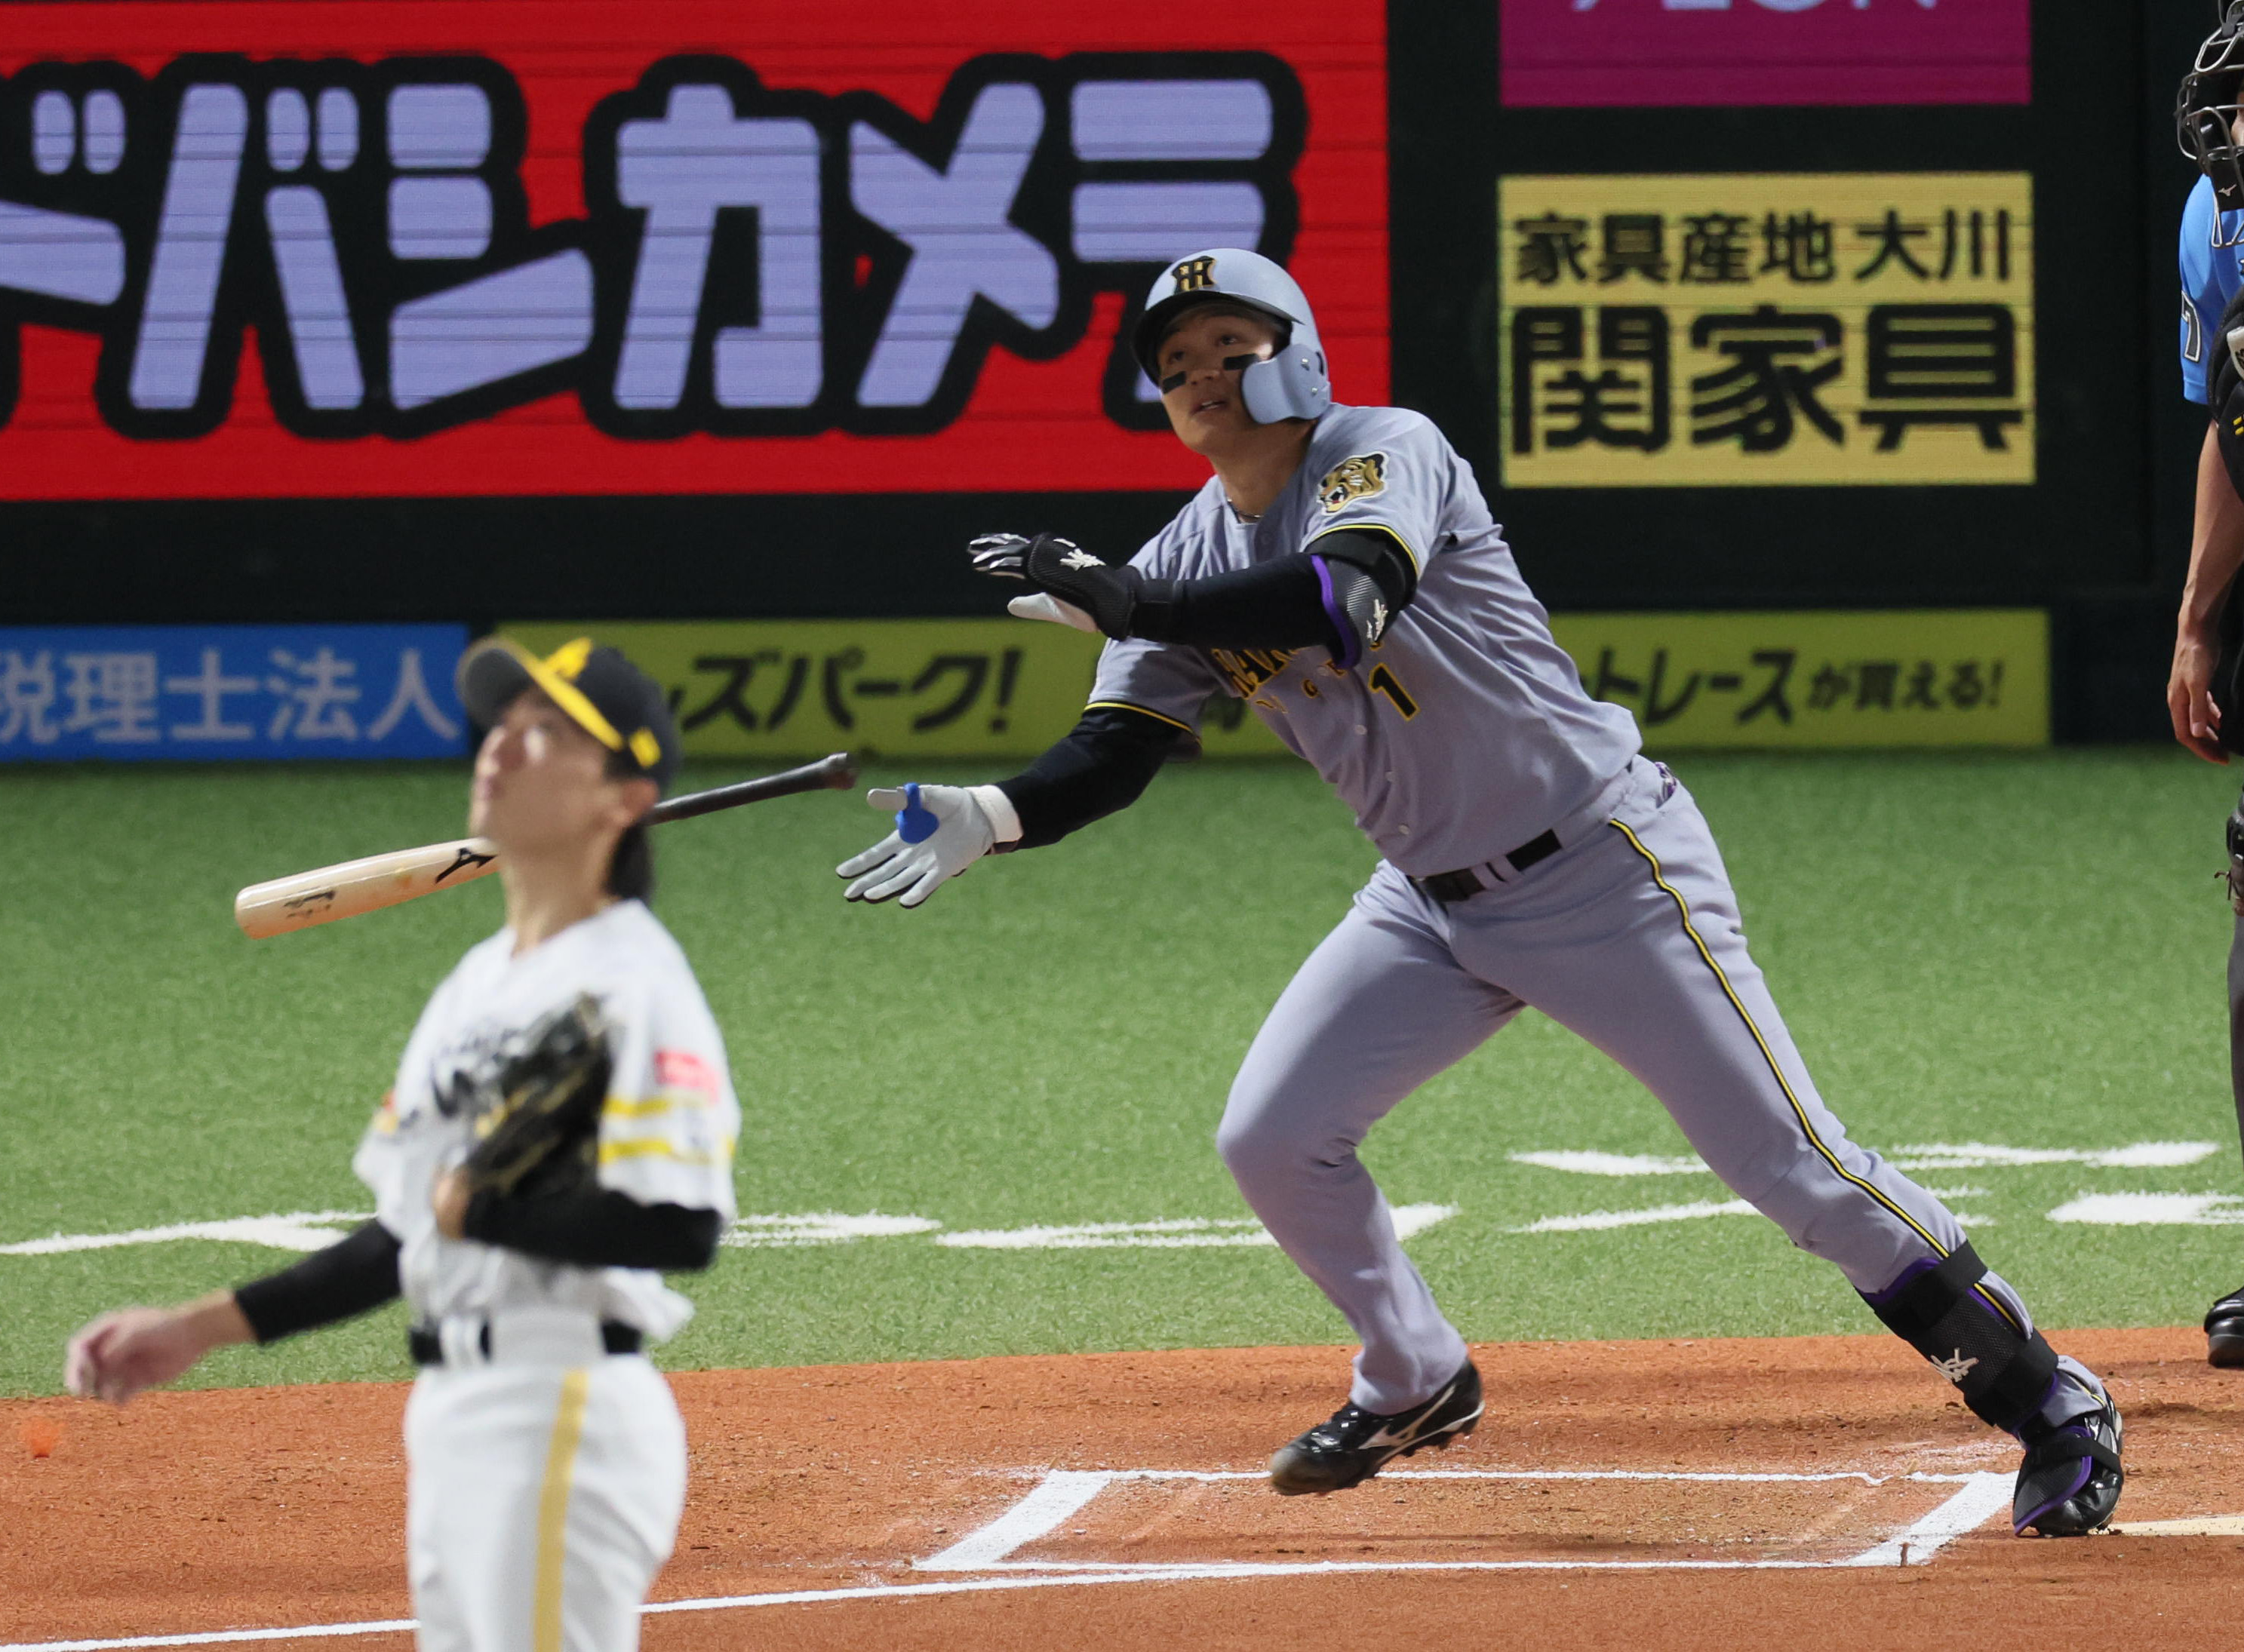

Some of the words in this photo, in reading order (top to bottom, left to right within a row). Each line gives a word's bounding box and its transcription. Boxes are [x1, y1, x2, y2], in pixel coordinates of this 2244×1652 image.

[1511, 303, 2023, 455] 関家具
[667, 647, 1022, 733] ズパーク!
[1368, 662, 1420, 721] 1
